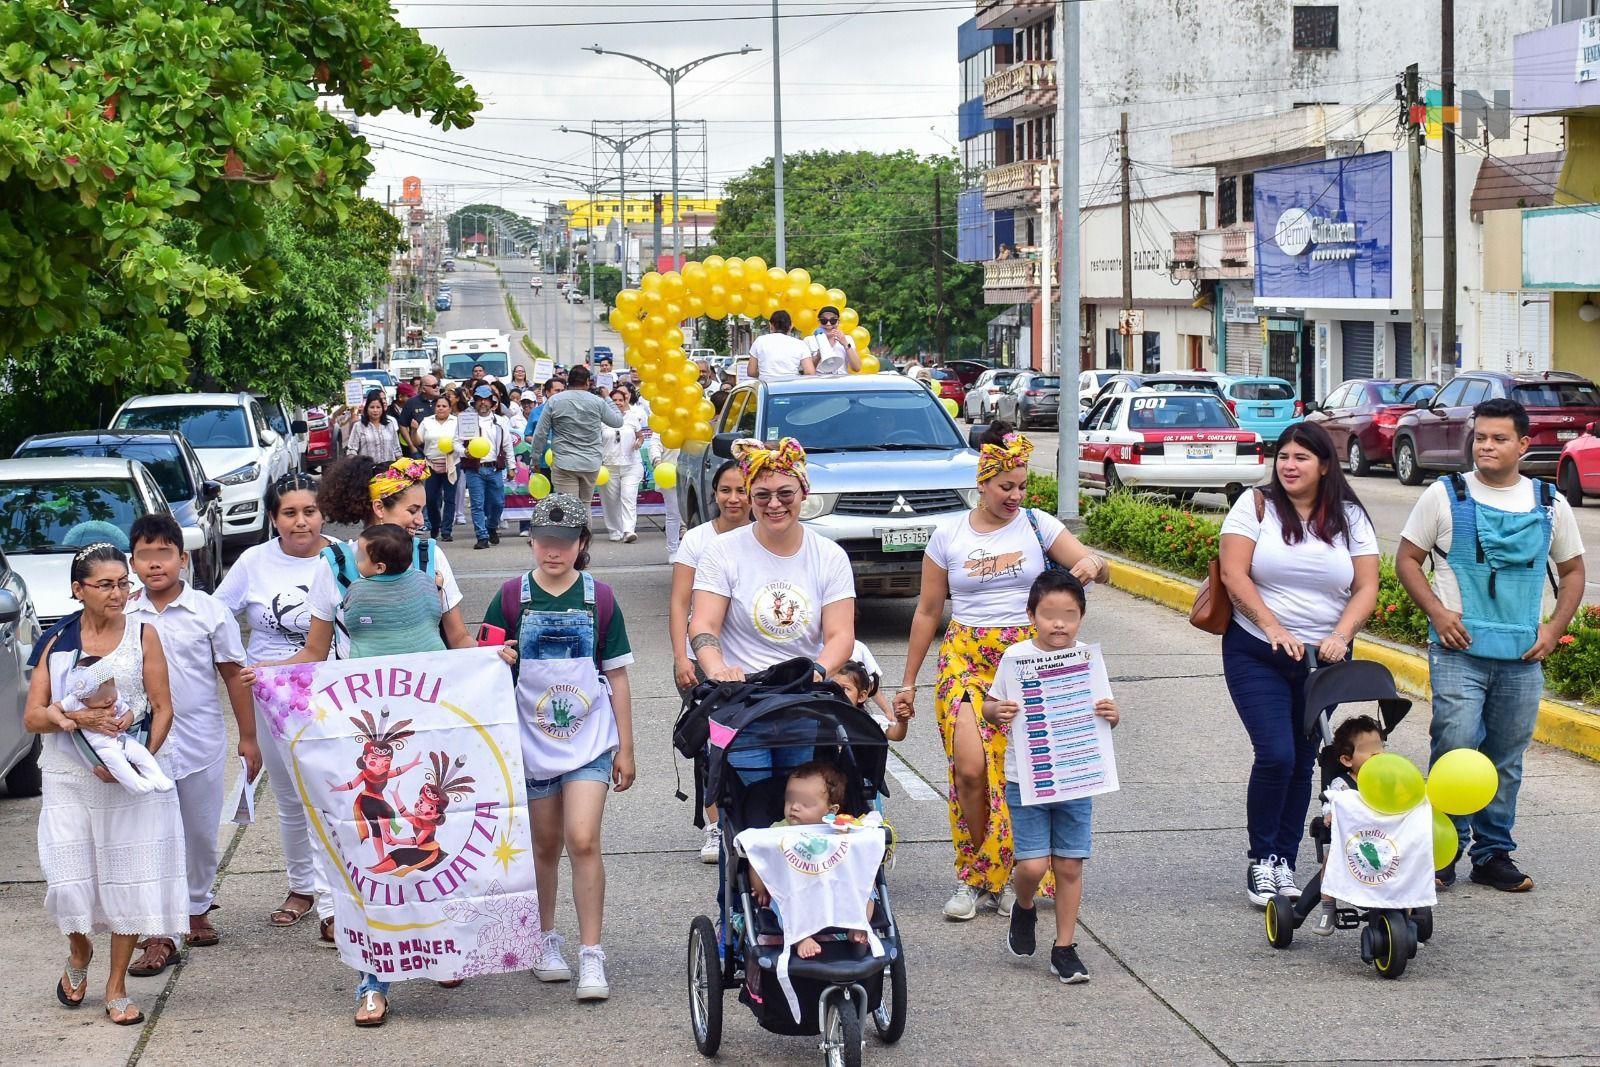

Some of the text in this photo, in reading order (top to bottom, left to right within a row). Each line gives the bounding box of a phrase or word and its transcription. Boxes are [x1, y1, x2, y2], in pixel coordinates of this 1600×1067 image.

[1280, 221, 1309, 246] Dermo
[1134, 398, 1166, 410] 901
[1121, 446, 1131, 460] 901
[968, 549, 998, 573] Stay
[980, 557, 1026, 583] Beautiful
[766, 582, 791, 592] TRIBU
[1034, 662, 1064, 670] LACTANCIA
[1053, 652, 1077, 660] CRIANZA
[318, 667, 442, 711] TRIBU
[550, 684, 579, 694] TRIBU
[537, 711, 583, 737] UBUNTU COAT
[1360, 829, 1386, 839] TRIBU
[415, 802, 500, 903] COATZA
[784, 841, 848, 872] UBUNTU COATZA
[1348, 855, 1399, 882] UBUNTU COATZA
[398, 938, 461, 956] MUJER,
